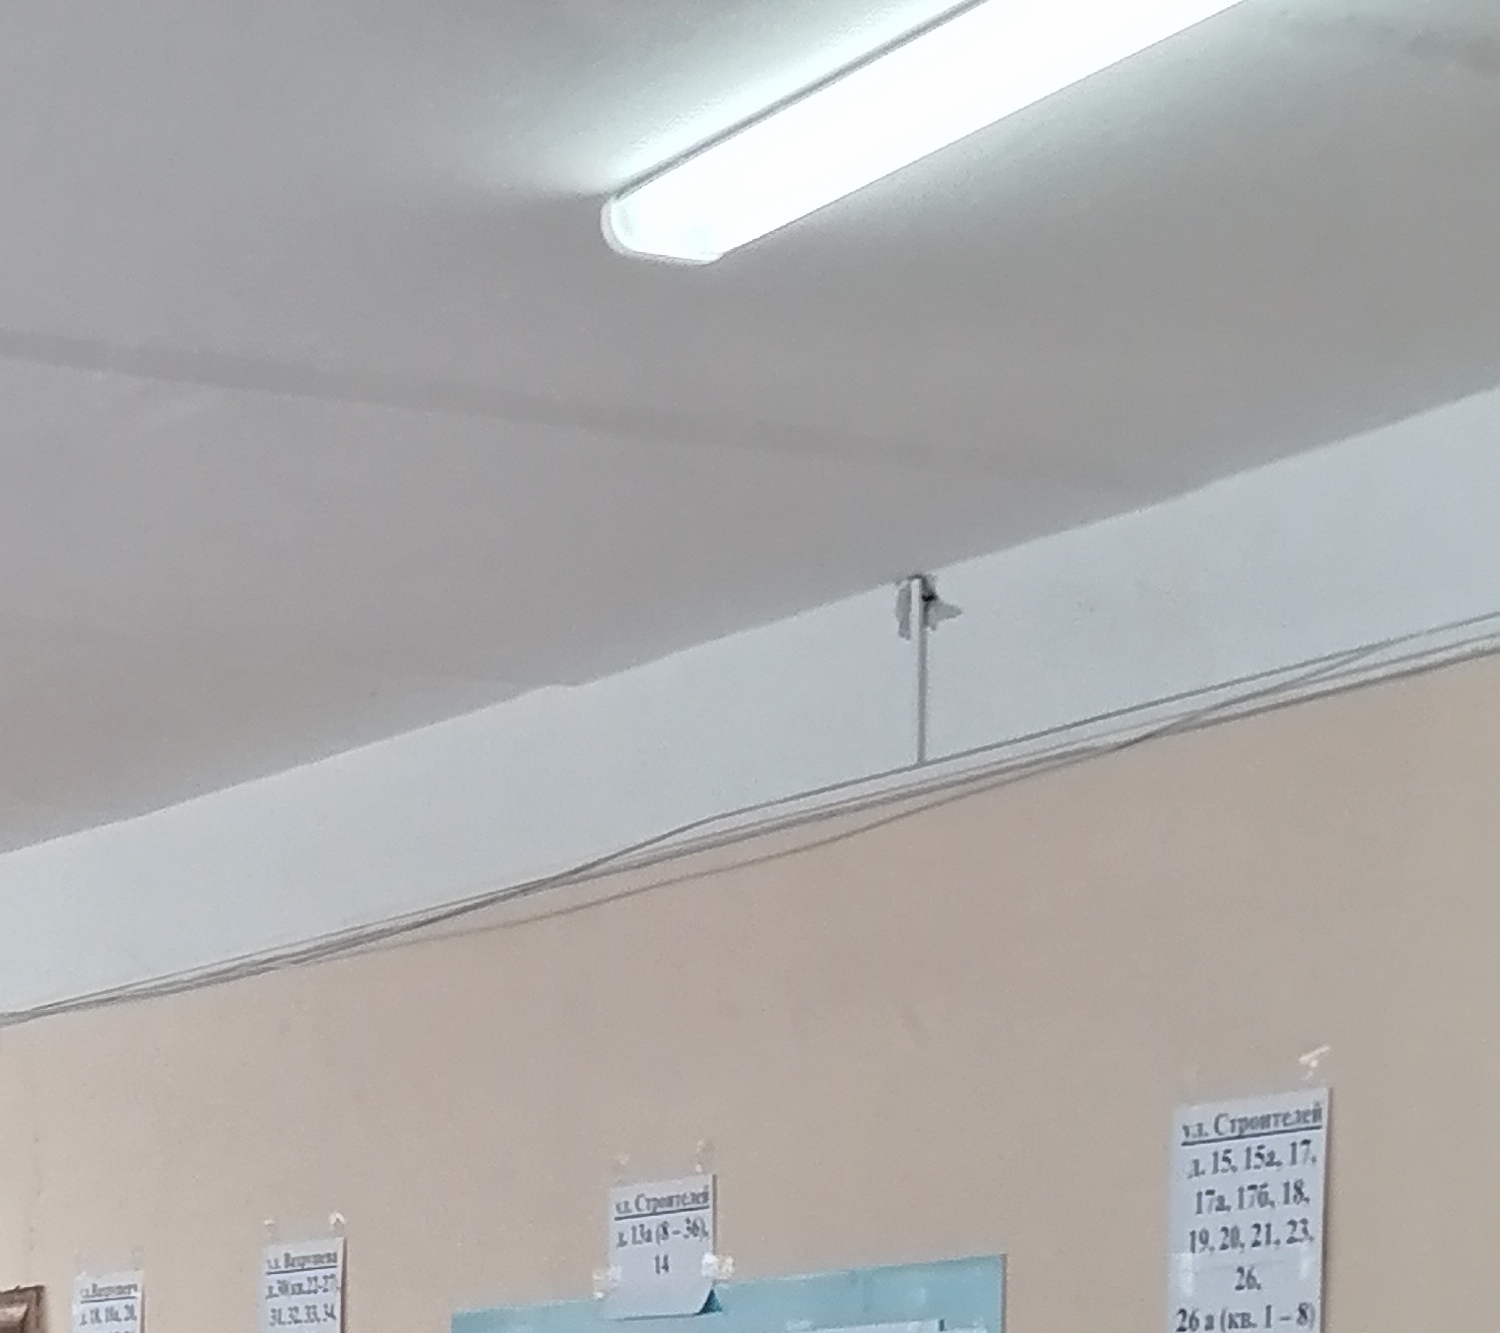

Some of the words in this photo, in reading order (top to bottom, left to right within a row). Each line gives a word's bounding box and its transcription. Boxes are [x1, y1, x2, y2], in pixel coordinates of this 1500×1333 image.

[1182, 1122, 1209, 1138] ул.
[1213, 1101, 1323, 1138] Строителей
[654, 1254, 669, 1274] 14
